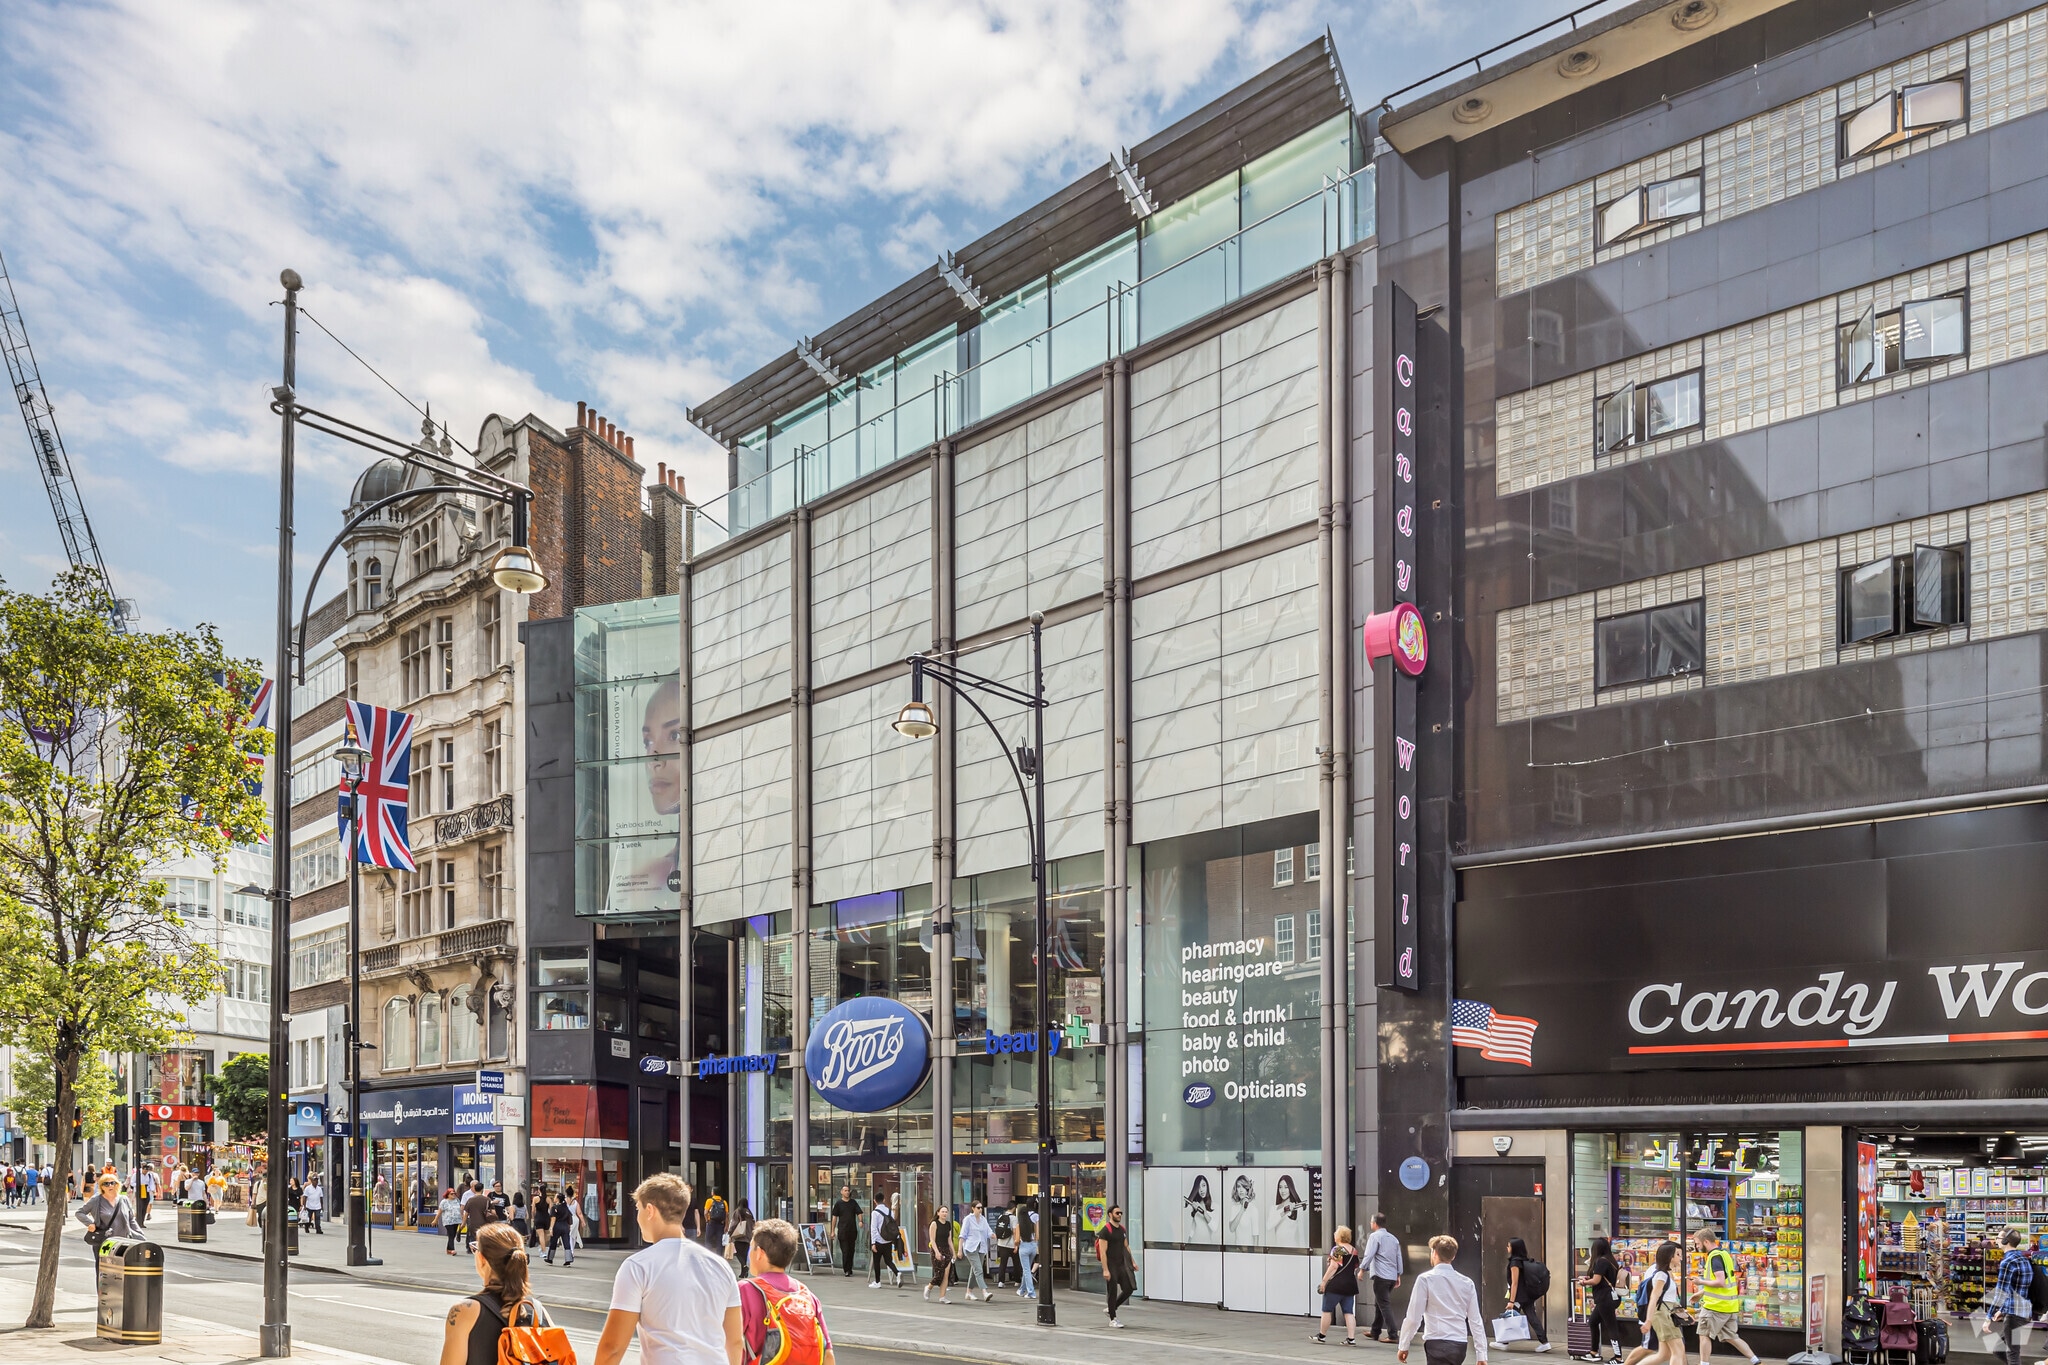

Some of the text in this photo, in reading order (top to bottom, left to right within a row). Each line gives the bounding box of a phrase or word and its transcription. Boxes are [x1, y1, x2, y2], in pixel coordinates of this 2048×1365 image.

[1396, 354, 1414, 592] Candy
[626, 841, 642, 849] week
[1396, 736, 1415, 978] World
[1182, 938, 1264, 964] pharmacy
[1182, 960, 1283, 984] hearingcare
[1182, 986, 1238, 1006] beauty
[1628, 961, 2048, 1036] Candy Wo
[1182, 1004, 1287, 1028] food & drink
[985, 1028, 1062, 1056] beauy
[1182, 1026, 1285, 1053] baby & child
[816, 1014, 905, 1091] Boots
[644, 1059, 666, 1072] Boots
[699, 1053, 778, 1080] pharmacy
[1182, 1055, 1230, 1077] photo
[481, 1075, 503, 1083] MONEY
[1185, 1079, 1307, 1104] Boots Opticians
[463, 1093, 493, 1105] MONEY
